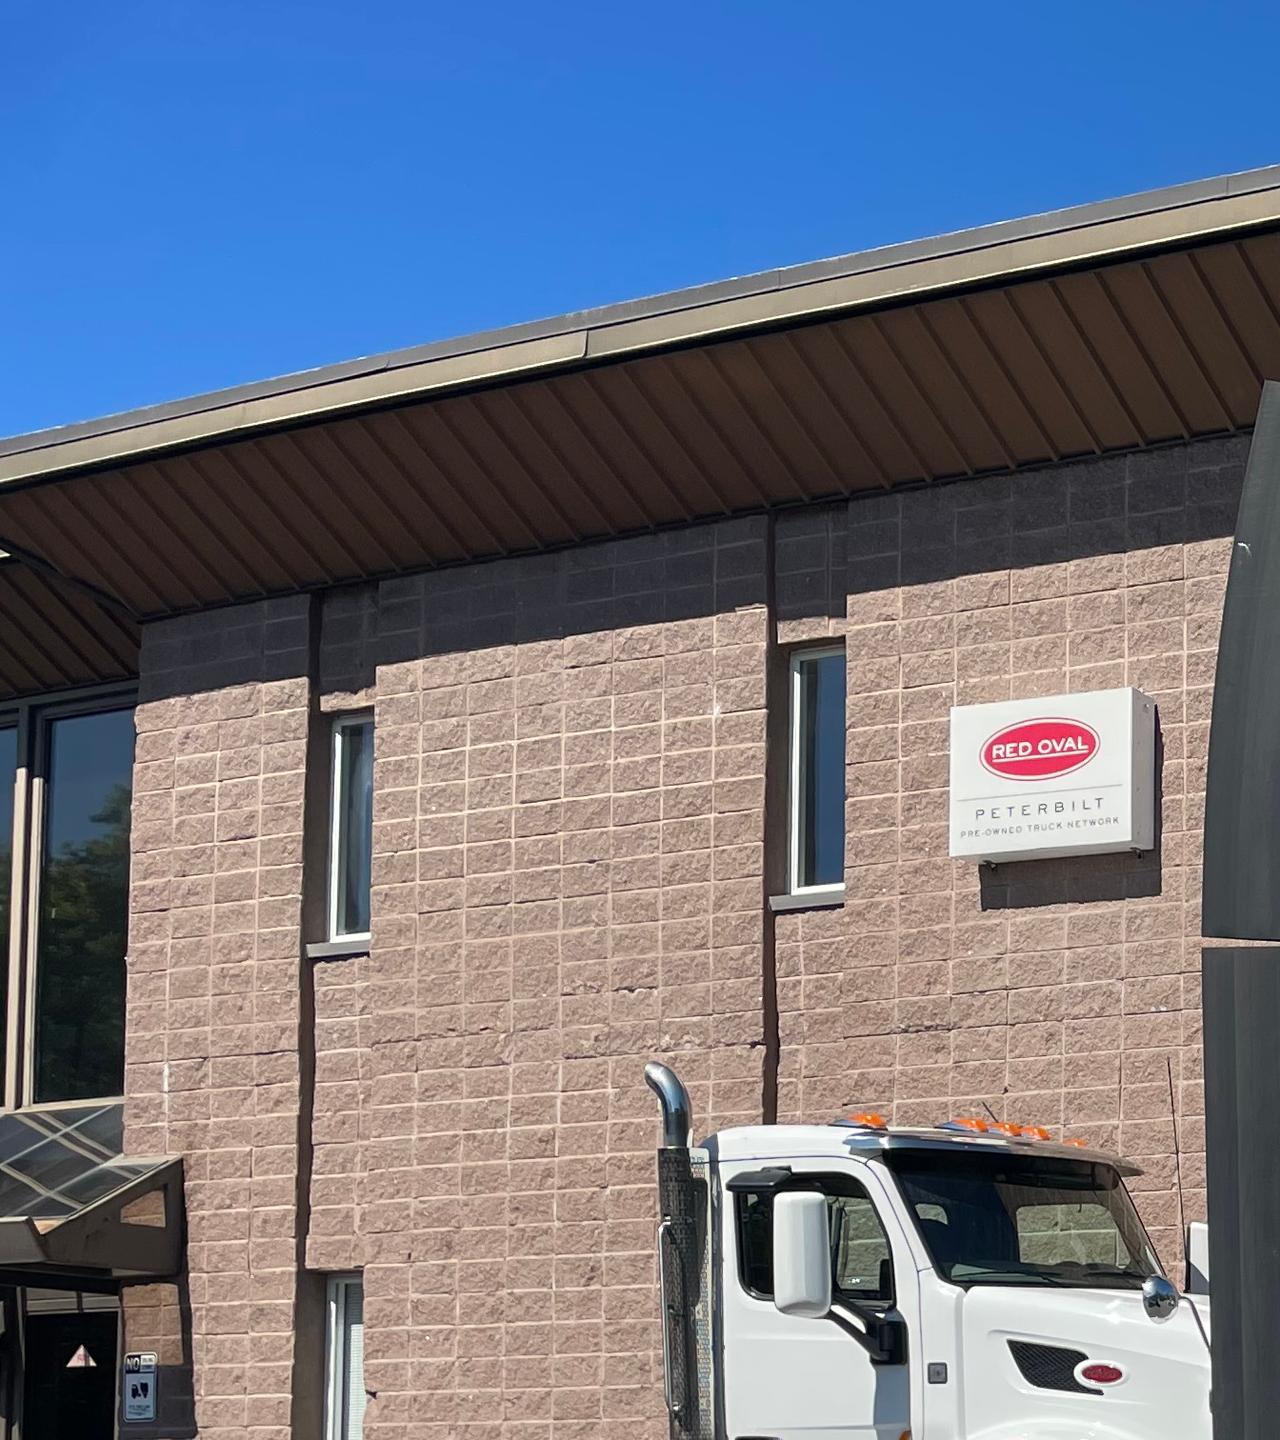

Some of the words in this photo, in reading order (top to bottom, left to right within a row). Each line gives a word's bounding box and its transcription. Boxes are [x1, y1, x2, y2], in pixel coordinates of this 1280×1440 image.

[992, 740, 1033, 759] RED
[1037, 735, 1090, 755] OVAL
[975, 797, 1105, 820] PETERBILT
[960, 826, 1023, 839] PRE-OWNED
[1027, 821, 1063, 833] TRUCK
[1067, 816, 1120, 830] NETWORK
